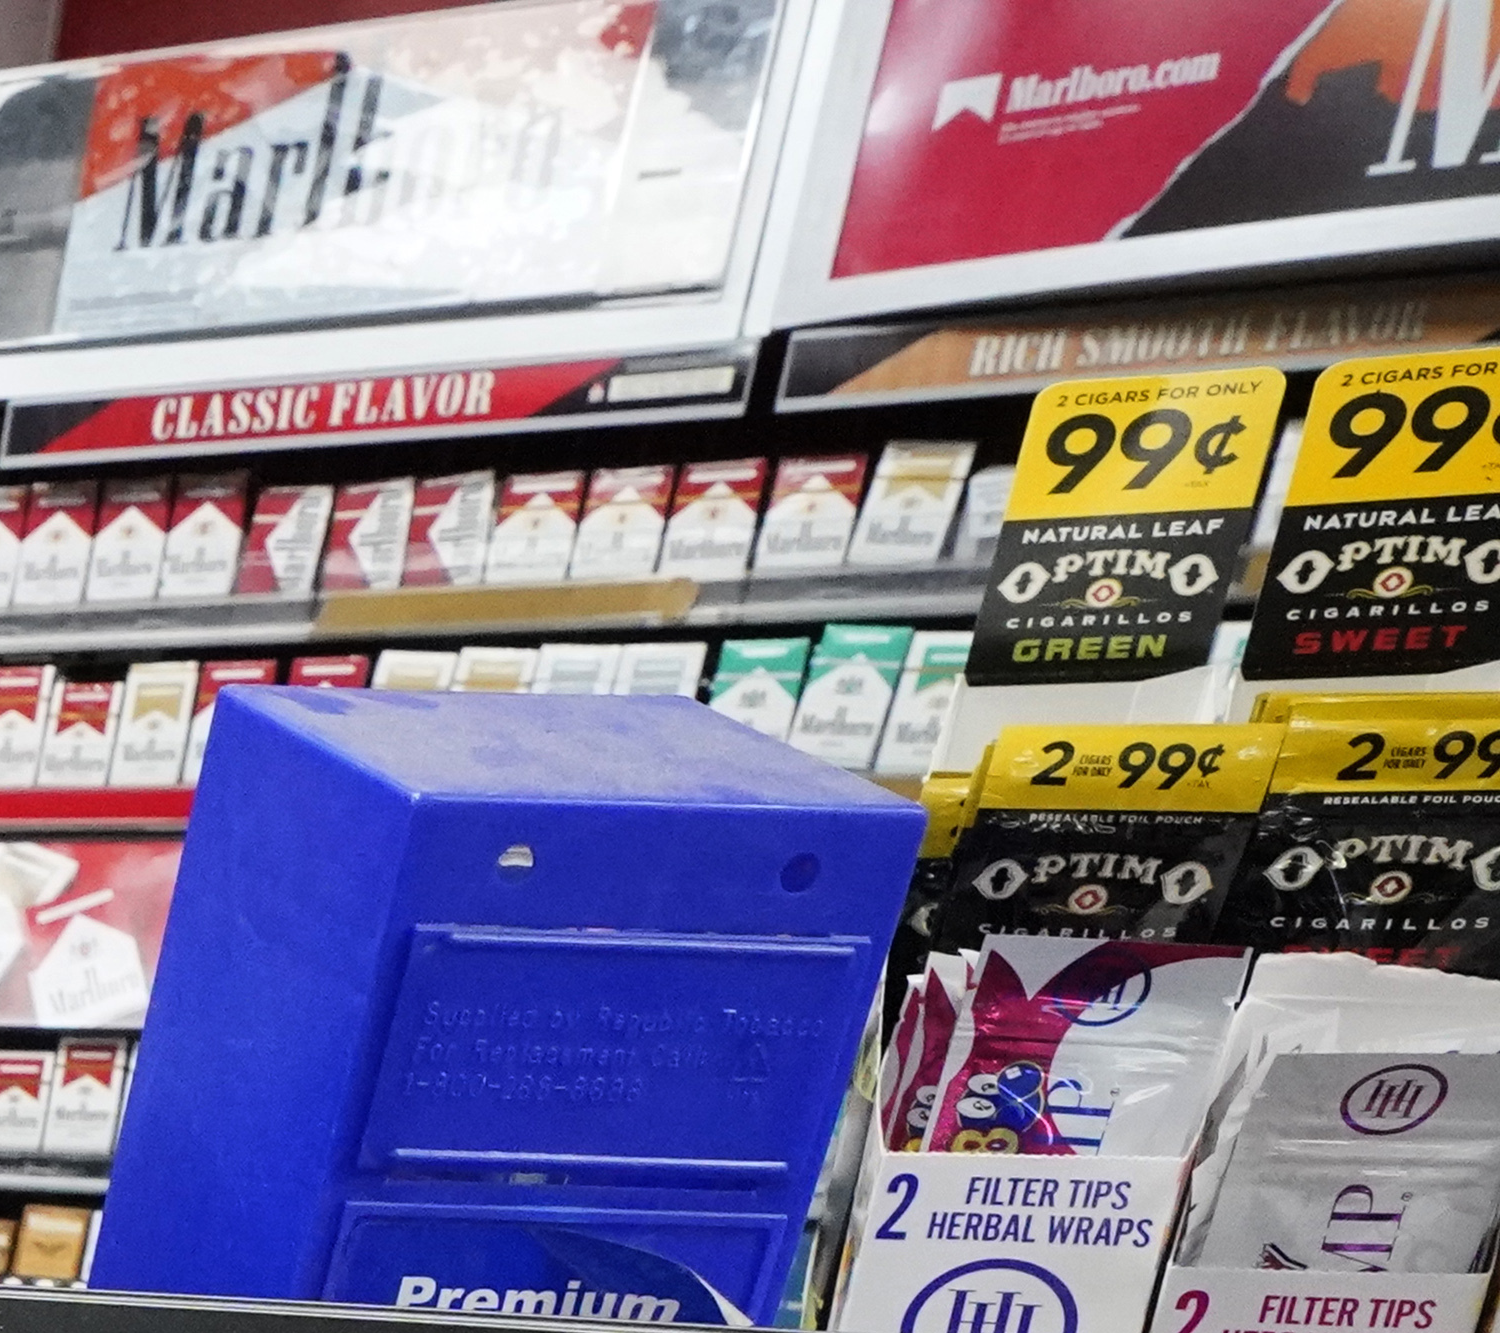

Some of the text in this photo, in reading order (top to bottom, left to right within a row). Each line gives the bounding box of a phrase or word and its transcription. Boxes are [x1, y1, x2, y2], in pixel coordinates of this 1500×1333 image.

[1006, 53, 1220, 113] Marlboro.com
[969, 302, 1424, 377] RICH SMOOTH FLAVOR
[1341, 362, 1499, 387] 2 CIGARS FOR
[152, 371, 495, 442] CLASSIC FLAVOR
[1057, 381, 1262, 407] 2 CIGARS FOR ONLY
[1329, 384, 1500, 480] 99
[1046, 409, 1247, 495] 99¢
[1022, 517, 1224, 545] NATURAL LEAF
[1303, 504, 1500, 530] NATURAL LEA
[998, 549, 1219, 603] OPTIMO
[1277, 535, 1500, 594] OPTIMO
[1006, 611, 1193, 629] CIGARILLOS
[1286, 599, 1489, 621] CIGARILLOS
[1011, 633, 1167, 663] GREEN
[1293, 625, 1467, 654] SWEET
[1030, 741, 1075, 786] 2
[1080, 755, 1112, 765] CIGARS
[1118, 740, 1225, 790] 99¢
[1337, 732, 1386, 780] 2
[1390, 746, 1426, 757] CIGARS
[1433, 731, 1500, 779] 99
[1029, 812, 1203, 825] RESEALABLE FOIL POUCH
[1323, 795, 1500, 806] RESEALABLE FOIL POUC
[972, 854, 1214, 903] OPTIMO
[1270, 917, 1489, 930] CIGARILLOS
[875, 1174, 1132, 1241] 2 FILTER TIPS
[927, 1211, 1153, 1248] HERBAL WRAPS
[396, 1275, 681, 1322] Premium
[1258, 1295, 1357, 1328] FILTER
[1368, 1299, 1437, 1330] TIPS
